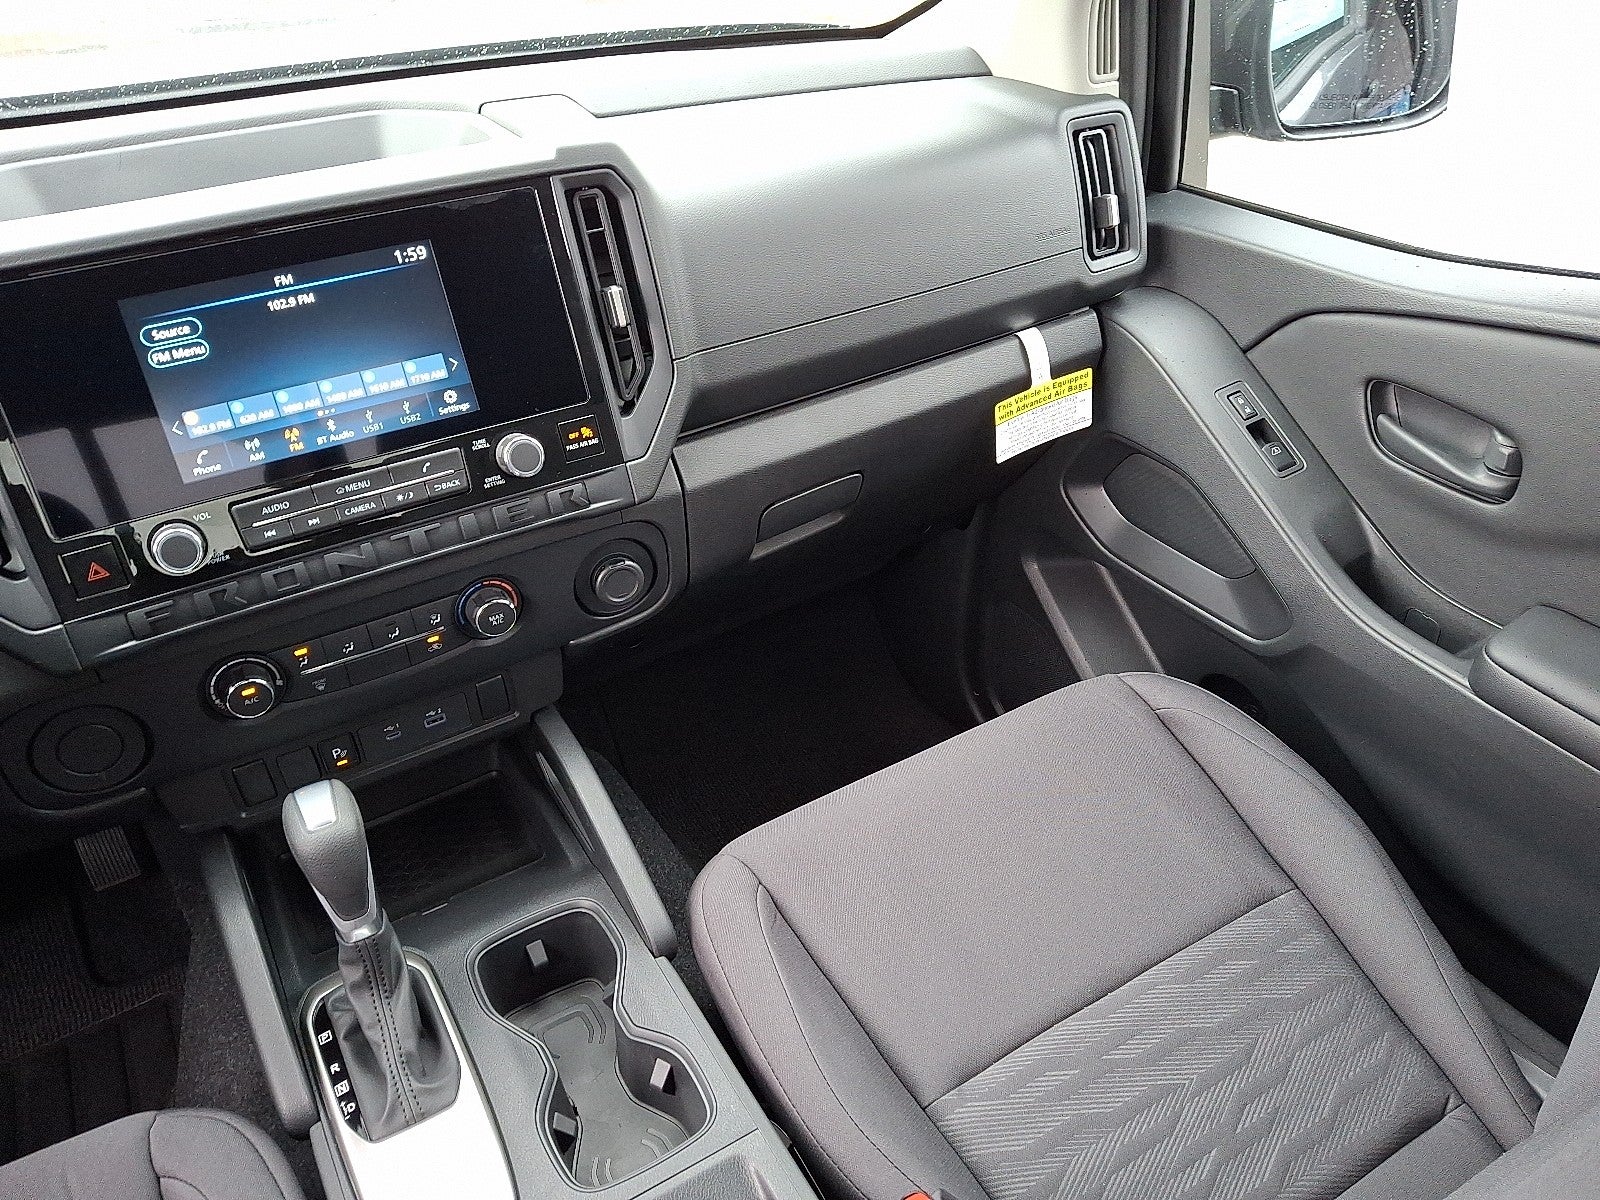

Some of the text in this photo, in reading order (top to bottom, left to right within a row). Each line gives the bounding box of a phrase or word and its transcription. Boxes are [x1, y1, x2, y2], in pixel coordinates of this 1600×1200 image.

[393, 245, 428, 264] 1:59
[273, 273, 294, 287] FM
[266, 292, 316, 312] 102.9 FM
[150, 323, 191, 341] Source
[152, 345, 206, 364] FM Menu
[430, 368, 447, 380] AM
[390, 377, 406, 390] AM
[997, 401, 1013, 413] This
[1014, 389, 1041, 405] Vehicle
[1043, 385, 1051, 393] is
[1052, 371, 1089, 389] Equipped
[998, 381, 1088, 422] with Advanced Air Bags
[258, 408, 275, 420] AM
[438, 402, 471, 417] Settings
[400, 412, 422, 425] USB2
[362, 422, 385, 434] USB1
[316, 428, 355, 446] BT Audio
[472, 437, 486, 446] TUNE
[568, 431, 580, 440] OFF
[288, 441, 305, 452] FM
[566, 443, 580, 452] PASS
[249, 451, 266, 462] AM
[192, 463, 222, 477] Phone
[441, 478, 461, 490] BACK
[483, 479, 506, 490] SETTING
[484, 474, 501, 484] ENTER
[344, 479, 371, 493] MENU
[261, 500, 290, 516] AUDIO
[344, 501, 377, 517] CAMERA
[192, 511, 212, 522] VOL
[127, 483, 590, 640] FRONTIER
[488, 612, 505, 622] MAX
[492, 617, 505, 627] A/C
[244, 695, 260, 706] A/C
[331, 747, 341, 760] P
[329, 1062, 341, 1075] R
